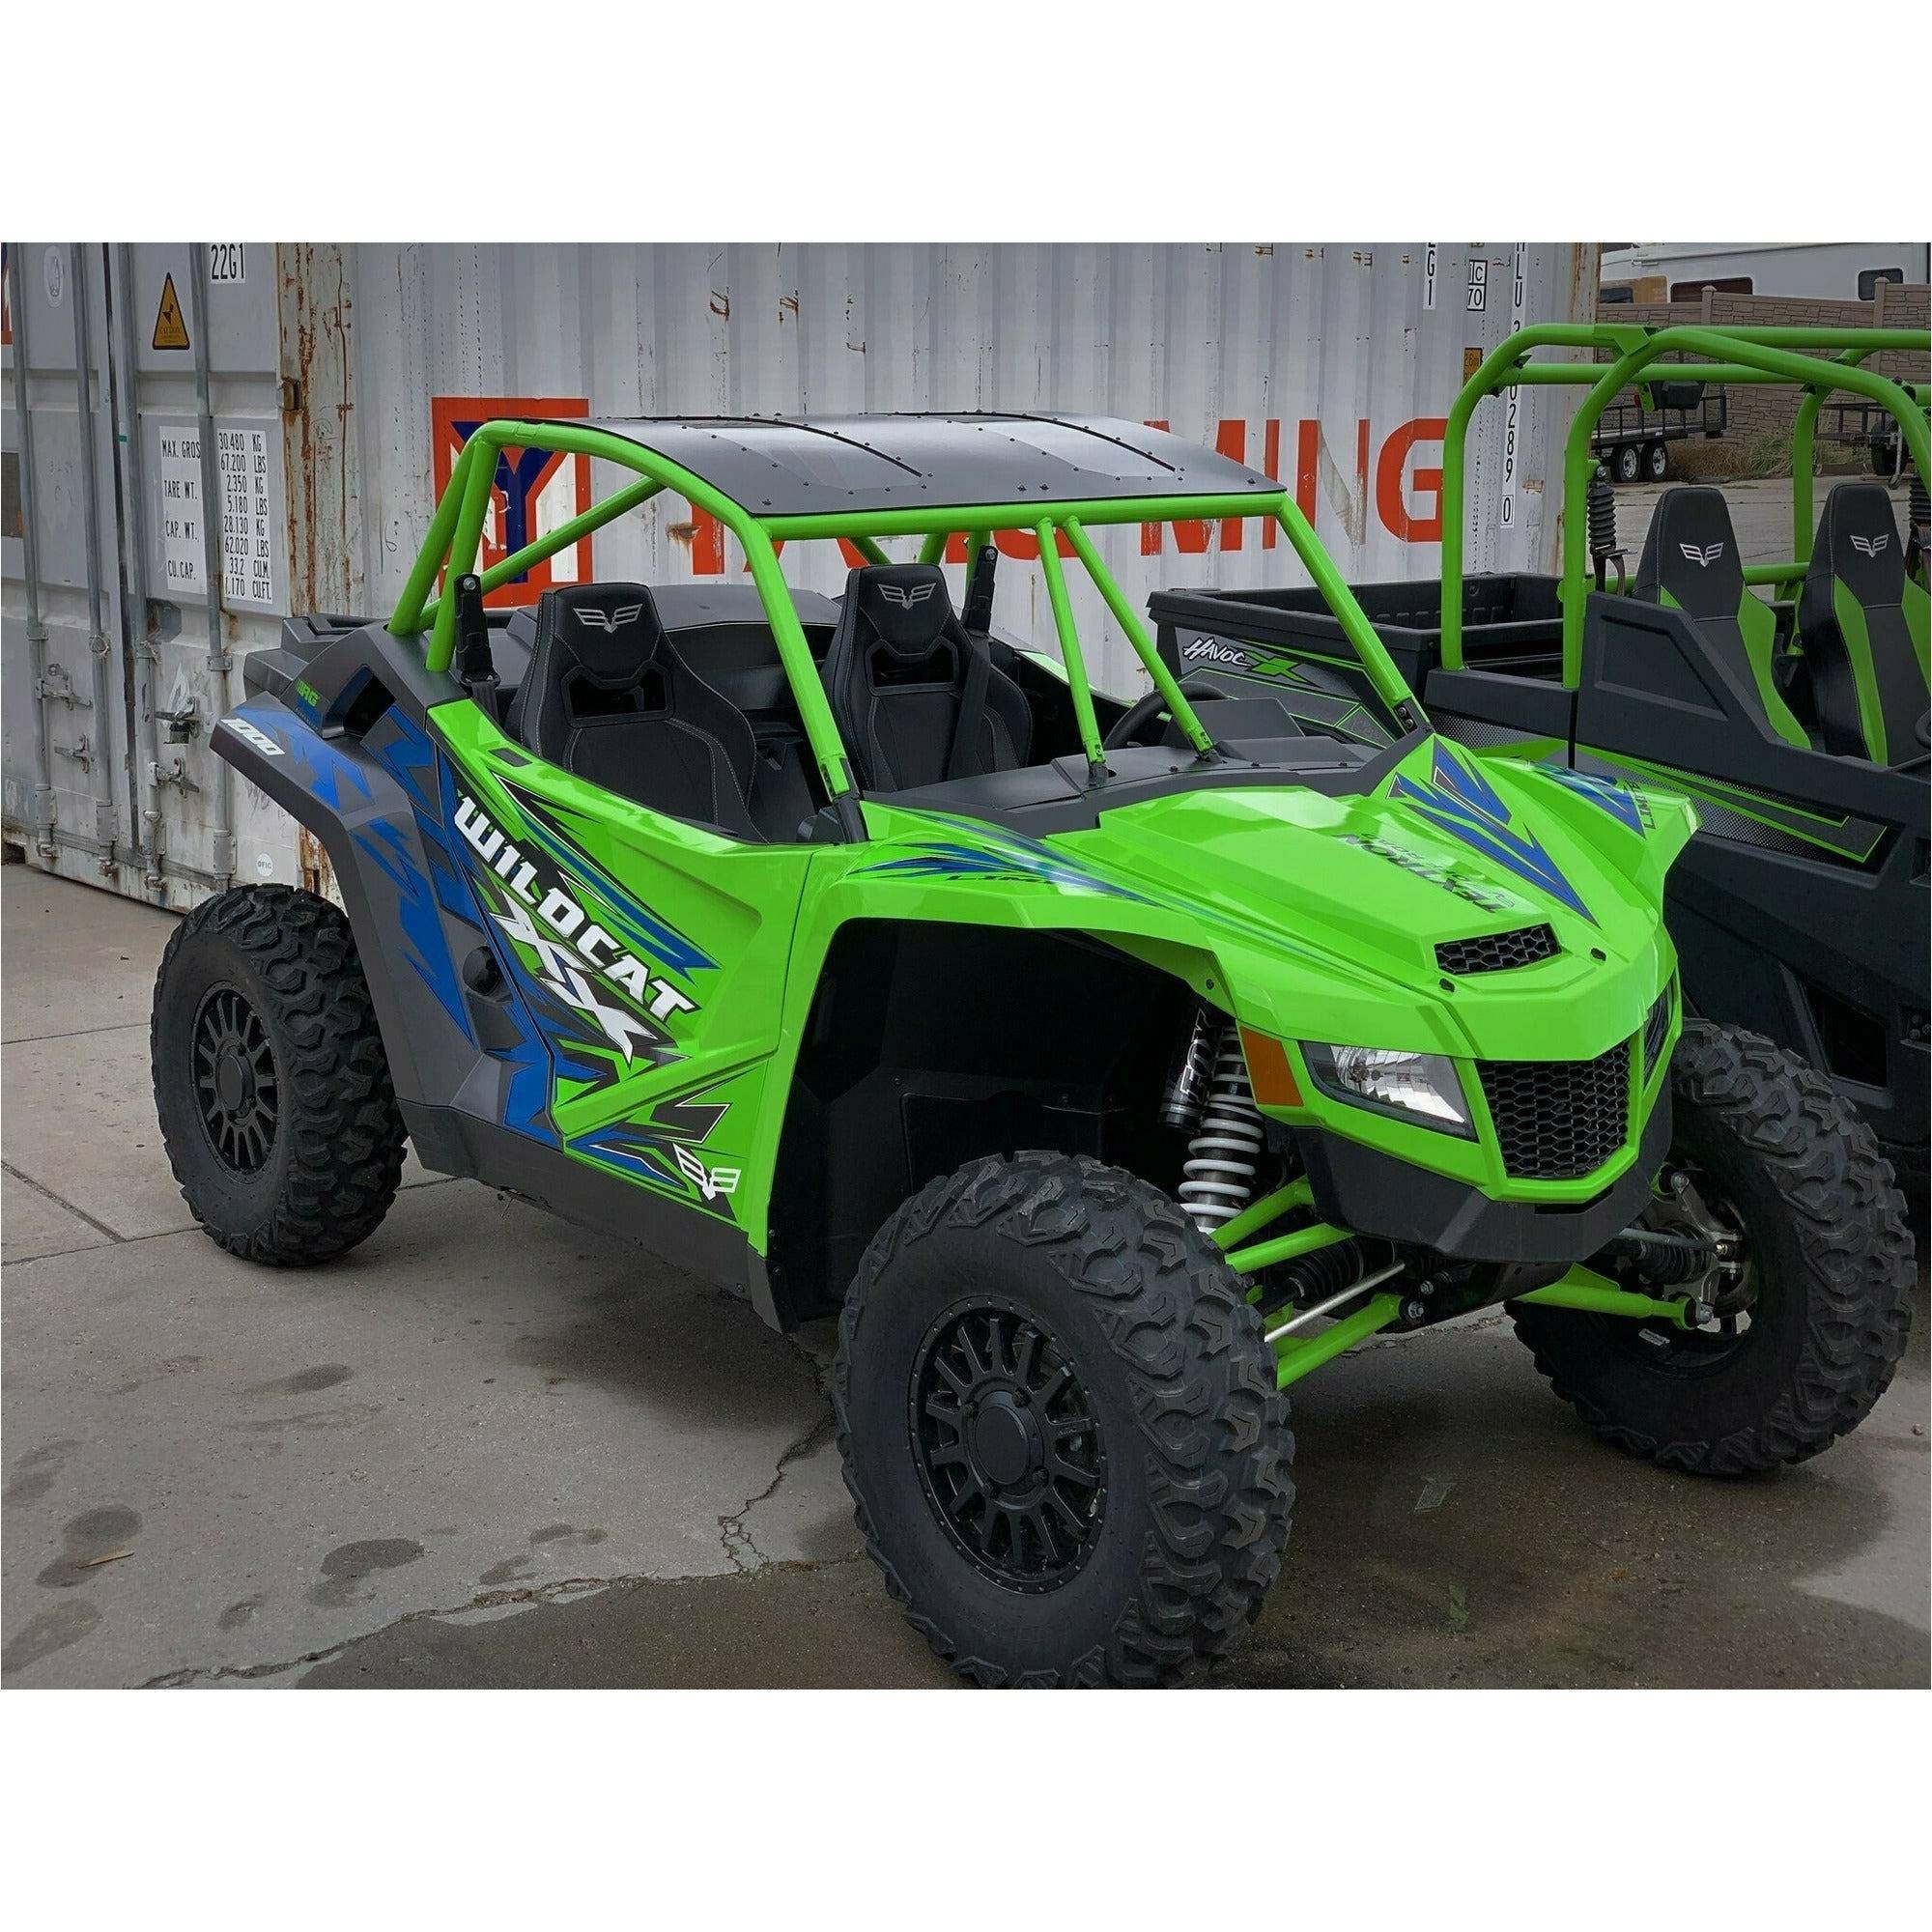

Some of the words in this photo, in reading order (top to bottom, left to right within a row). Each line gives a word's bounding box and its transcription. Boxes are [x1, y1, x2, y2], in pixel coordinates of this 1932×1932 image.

[211, 242, 244, 280] 22G1
[162, 440, 179, 458] MAX.
[218, 432, 244, 451] 30.480
[252, 433, 262, 452] KG
[220, 453, 246, 472] 67.200
[254, 454, 267, 473] LBS
[163, 480, 181, 498] TARE
[184, 481, 198, 499] WT.
[227, 474, 247, 494] 2.350
[254, 476, 264, 495] KG
[228, 495, 248, 514] 5.180
[255, 497, 268, 516] LBS
[165, 520, 182, 539] CAP.
[184, 522, 198, 540] WT.
[224, 515, 249, 534] 28.130
[255, 518, 265, 536] KG
[256, 539, 270, 558] LBS
[229, 556, 244, 576] 33.2
[1181, 638, 1253, 668] HAVOC
[219, 718, 287, 755] 1000
[453, 795, 699, 1023] WILDCAT
[489, 887, 660, 1065] XX
